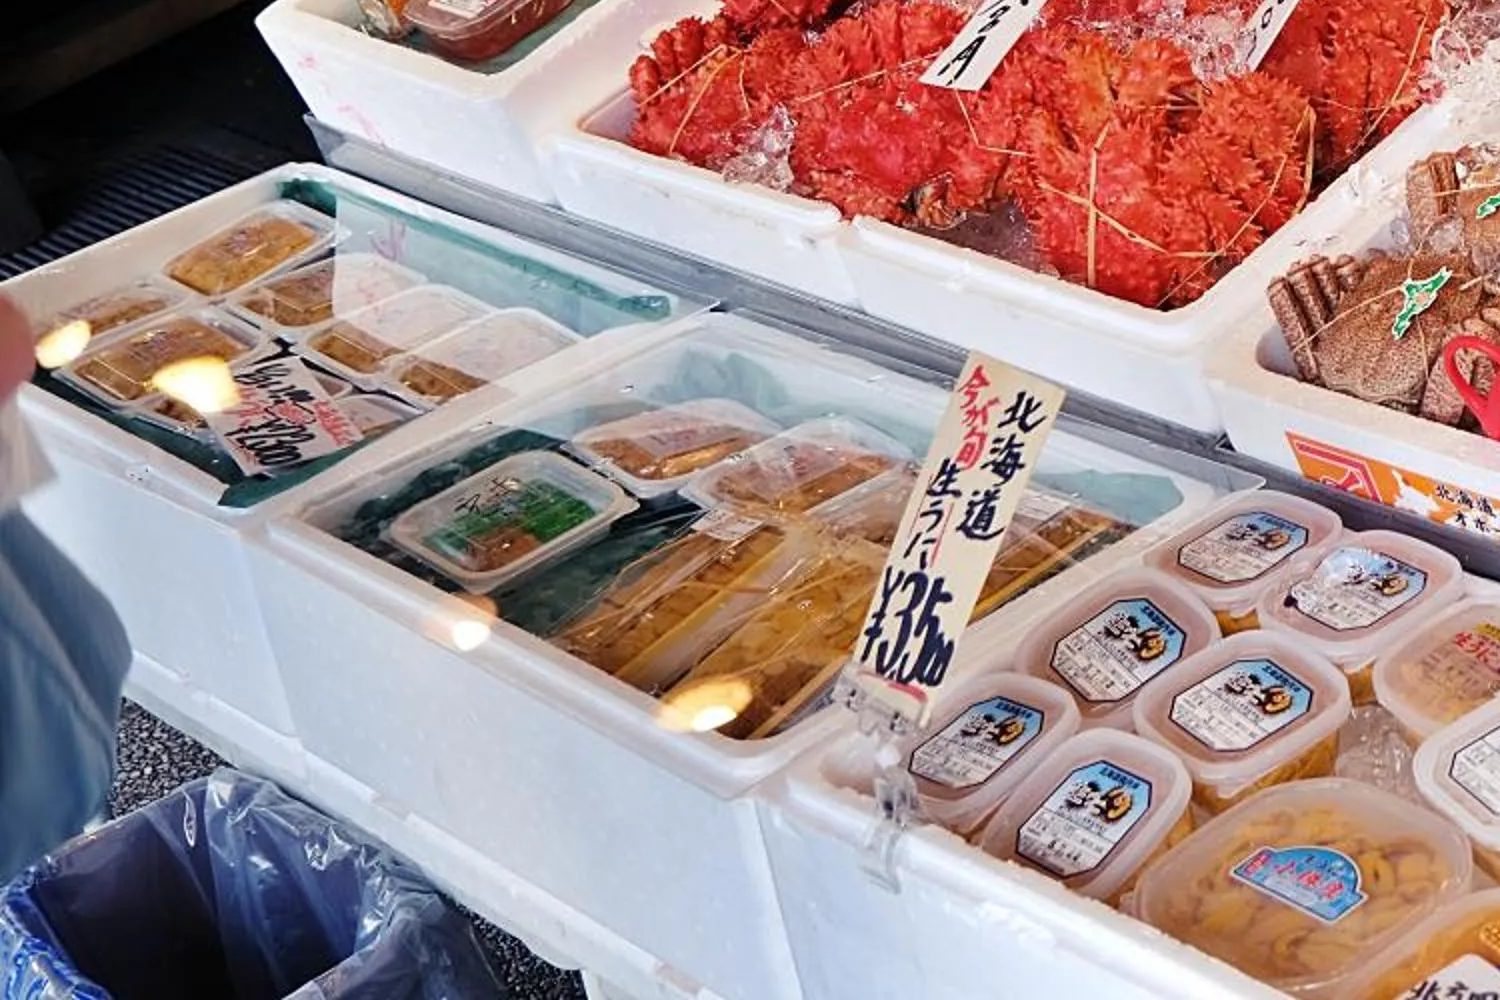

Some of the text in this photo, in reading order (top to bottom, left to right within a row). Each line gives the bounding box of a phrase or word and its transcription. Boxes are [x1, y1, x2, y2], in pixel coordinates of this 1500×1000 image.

[953, 364, 1001, 471] 今が旬
[955, 390, 1047, 542] 北海道
[902, 456, 962, 571] 生うに
